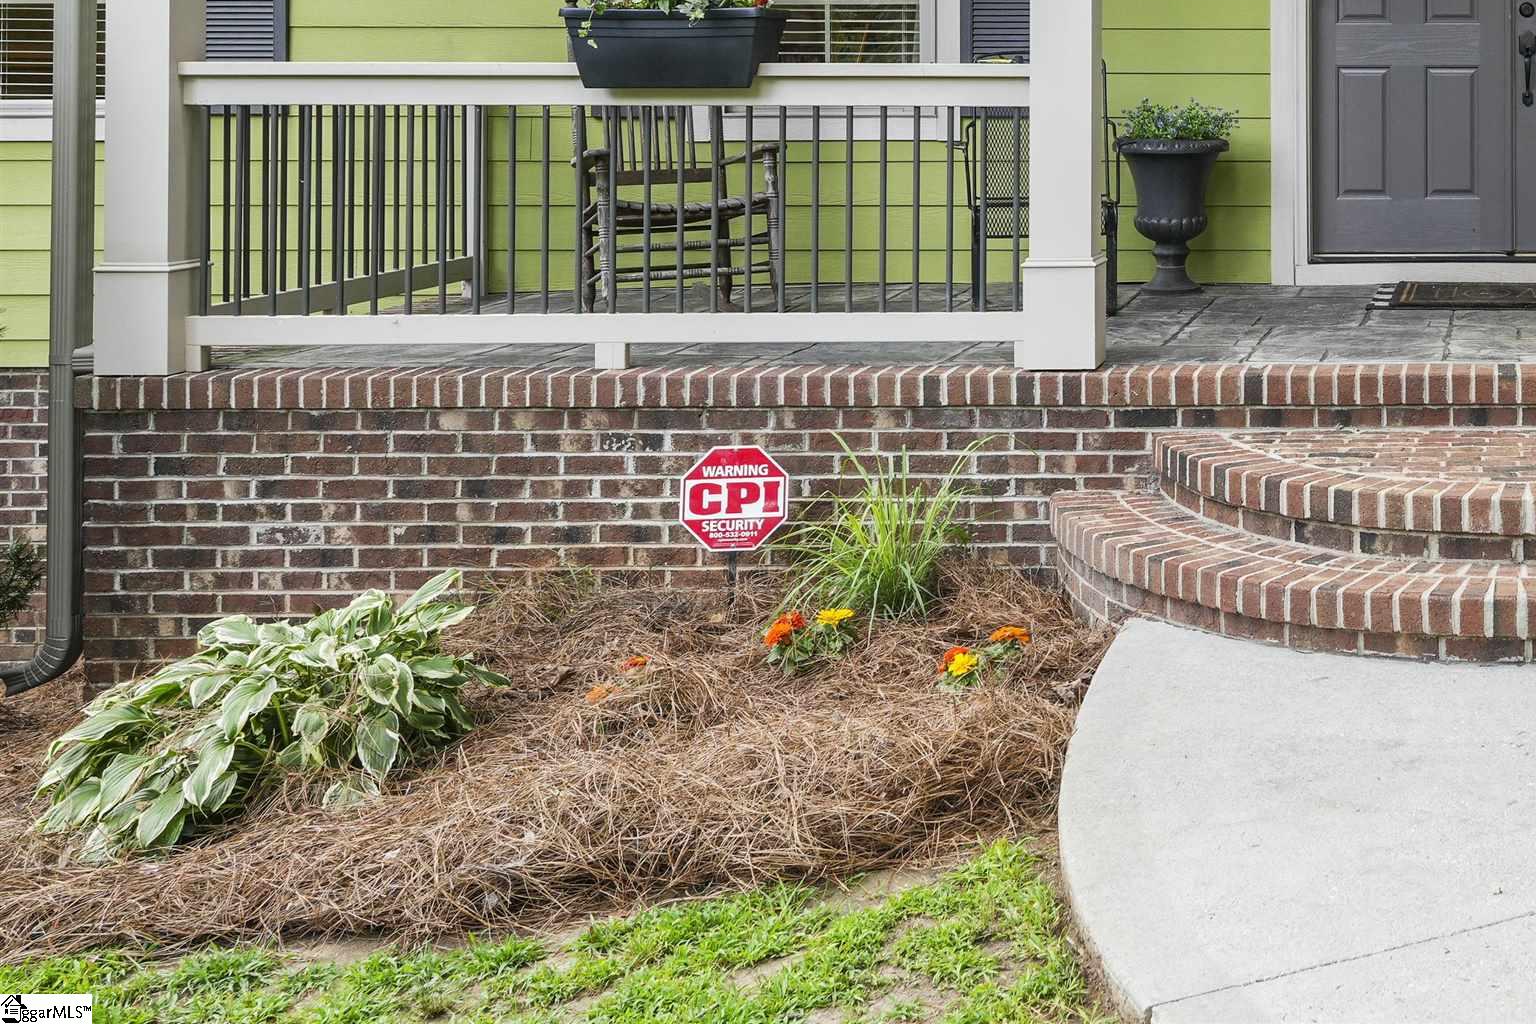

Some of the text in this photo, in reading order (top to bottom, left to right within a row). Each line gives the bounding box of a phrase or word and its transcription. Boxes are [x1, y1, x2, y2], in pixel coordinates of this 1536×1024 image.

[702, 464, 769, 477] WARNING
[688, 480, 780, 516] CPI
[701, 519, 765, 532] SECURITY
